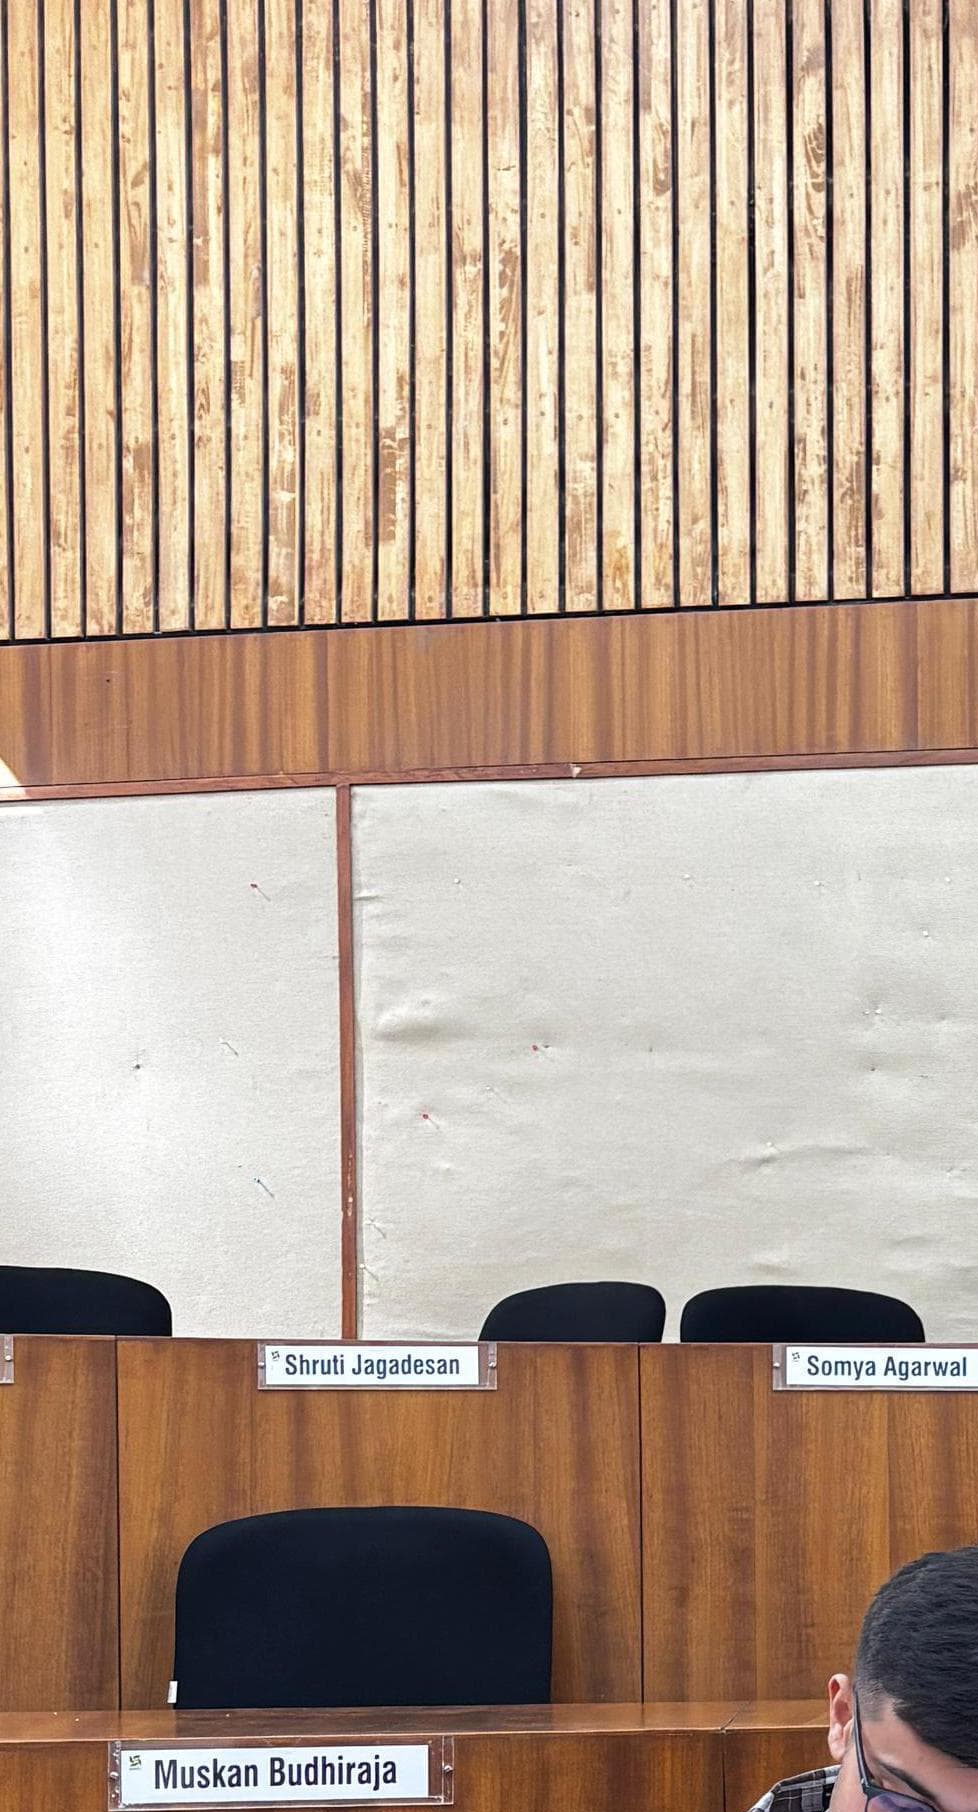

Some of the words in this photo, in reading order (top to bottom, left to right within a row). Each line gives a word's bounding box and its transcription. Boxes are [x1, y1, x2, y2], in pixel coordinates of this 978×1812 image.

[285, 1354, 345, 1375] Shruti
[351, 1354, 460, 1380] Jagadesan
[807, 1355, 876, 1381] Somya
[883, 1356, 967, 1381] Agarwal
[154, 1758, 258, 1790] Muskan
[269, 1754, 397, 1792] Budhiraja
